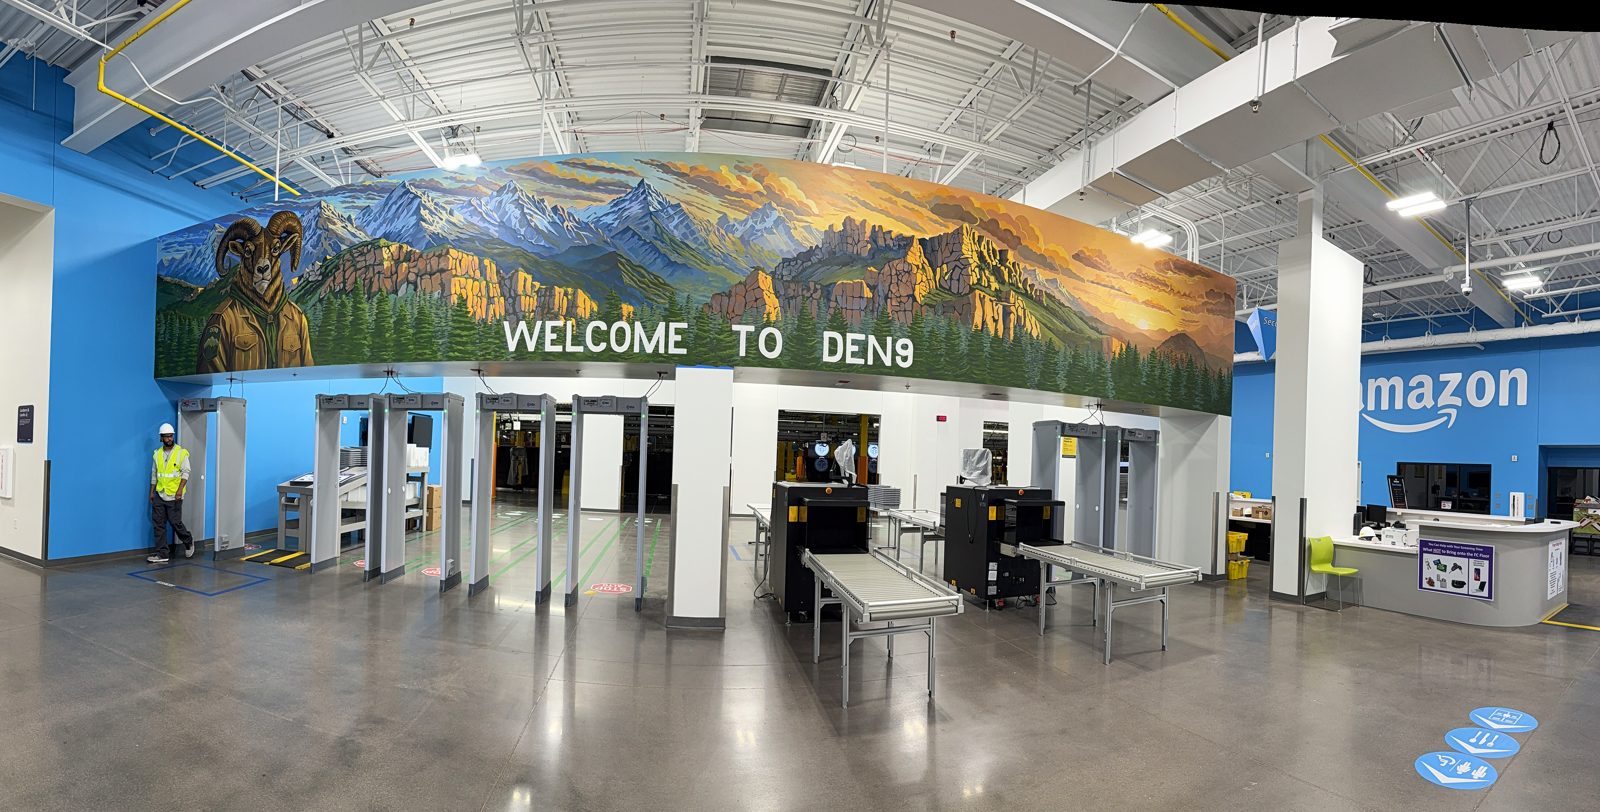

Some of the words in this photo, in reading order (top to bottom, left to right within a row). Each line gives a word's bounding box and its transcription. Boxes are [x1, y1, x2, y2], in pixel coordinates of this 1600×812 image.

[503, 320, 688, 354] WELCOME
[731, 324, 783, 359] TO
[822, 331, 914, 368] DEN9
[1360, 368, 1528, 411] mazon
